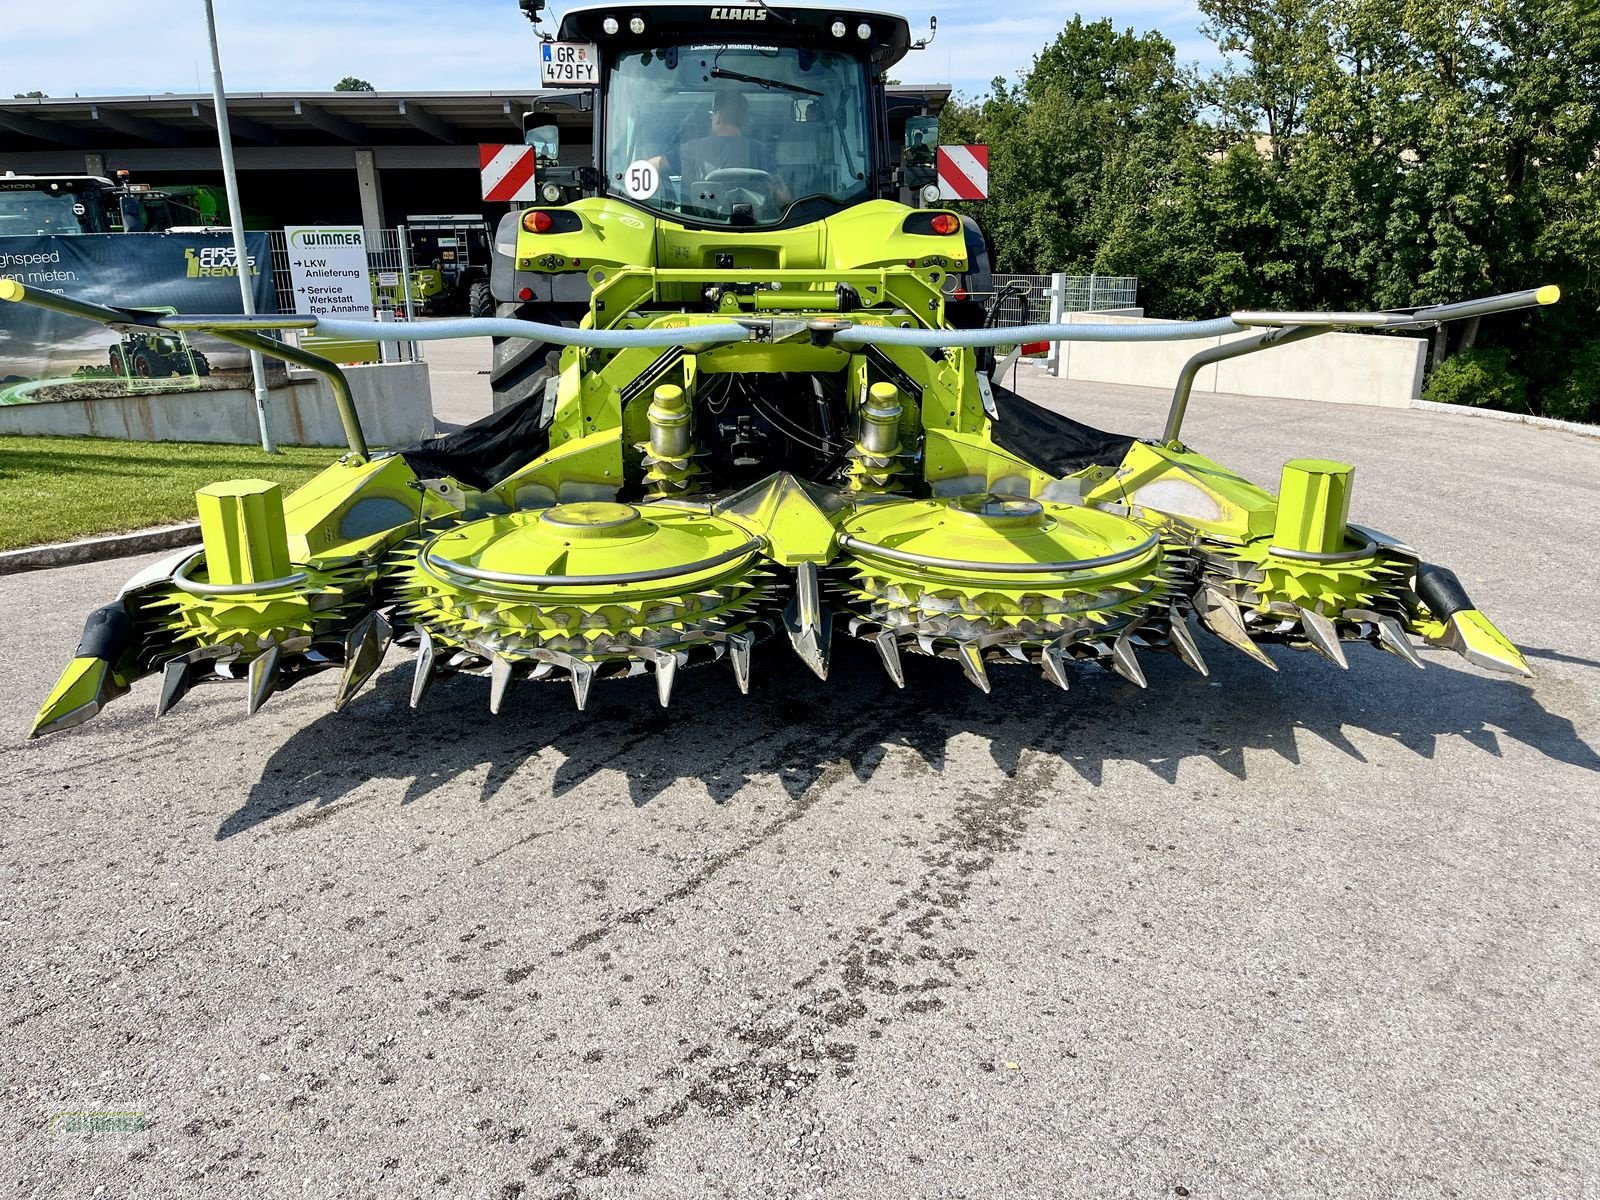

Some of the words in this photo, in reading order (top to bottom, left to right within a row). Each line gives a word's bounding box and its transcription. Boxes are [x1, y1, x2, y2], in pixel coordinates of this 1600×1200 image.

[710, 8, 767, 20] CLAAS
[557, 47, 575, 62] GR
[631, 168, 652, 192] 50
[302, 233, 361, 246] WIMMER
[200, 247, 248, 258] FIRS
[304, 260, 326, 268] LKW
[28, 269, 80, 283] mieten.
[305, 269, 360, 278] Anlieferung
[307, 286, 343, 294] Service
[308, 295, 354, 304] Werkstatt
[310, 306, 329, 315] Rep.
[331, 304, 370, 313] Annahme
